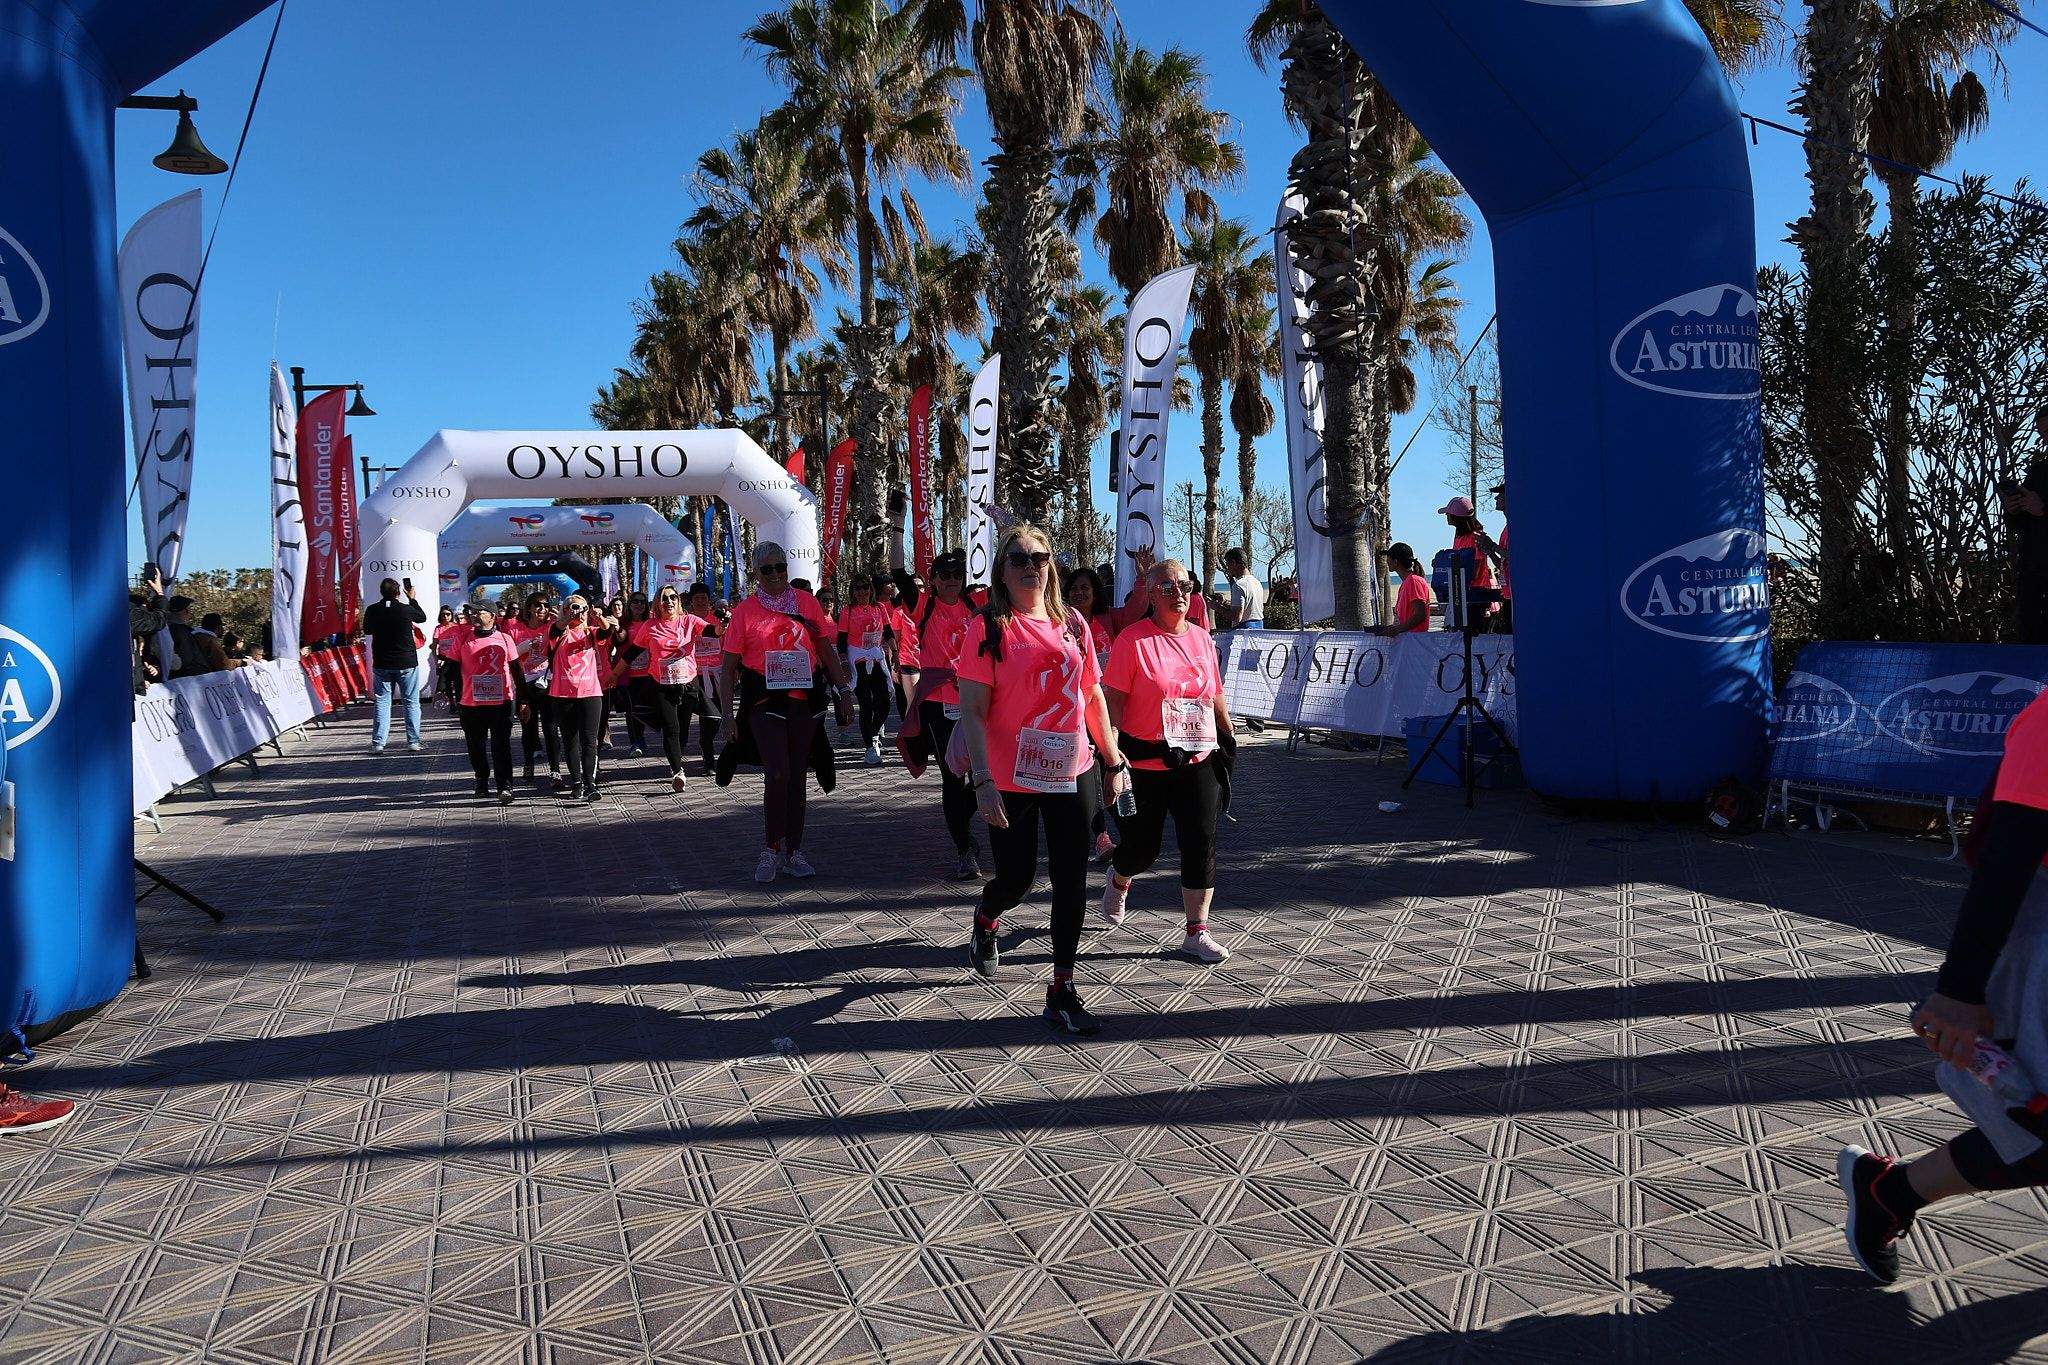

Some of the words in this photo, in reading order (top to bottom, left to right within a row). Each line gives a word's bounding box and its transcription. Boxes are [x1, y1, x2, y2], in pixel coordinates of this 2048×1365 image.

[1670, 324, 1737, 336] CENTRAL
[1125, 317, 1172, 560] OYSHO
[506, 444, 688, 480] OYSHO
[917, 415, 929, 513] Santander
[313, 422, 332, 528] Santander
[392, 486, 451, 499] OYSHO
[739, 480, 788, 492] OYSHO
[969, 397, 993, 580] OYSHO
[828, 462, 845, 535] Santander
[340, 467, 353, 549] Santander
[786, 548, 815, 560] SHO
[369, 559, 425, 573] OYSHO
[484, 559, 558, 568] VOLVO
[1680, 567, 1746, 582] CENTRAL
[1265, 643, 1384, 688] OYSHO
[1921, 699, 1986, 709] CENTRAL
[1181, 722, 1202, 731] 016
[1040, 758, 1064, 770] 016
